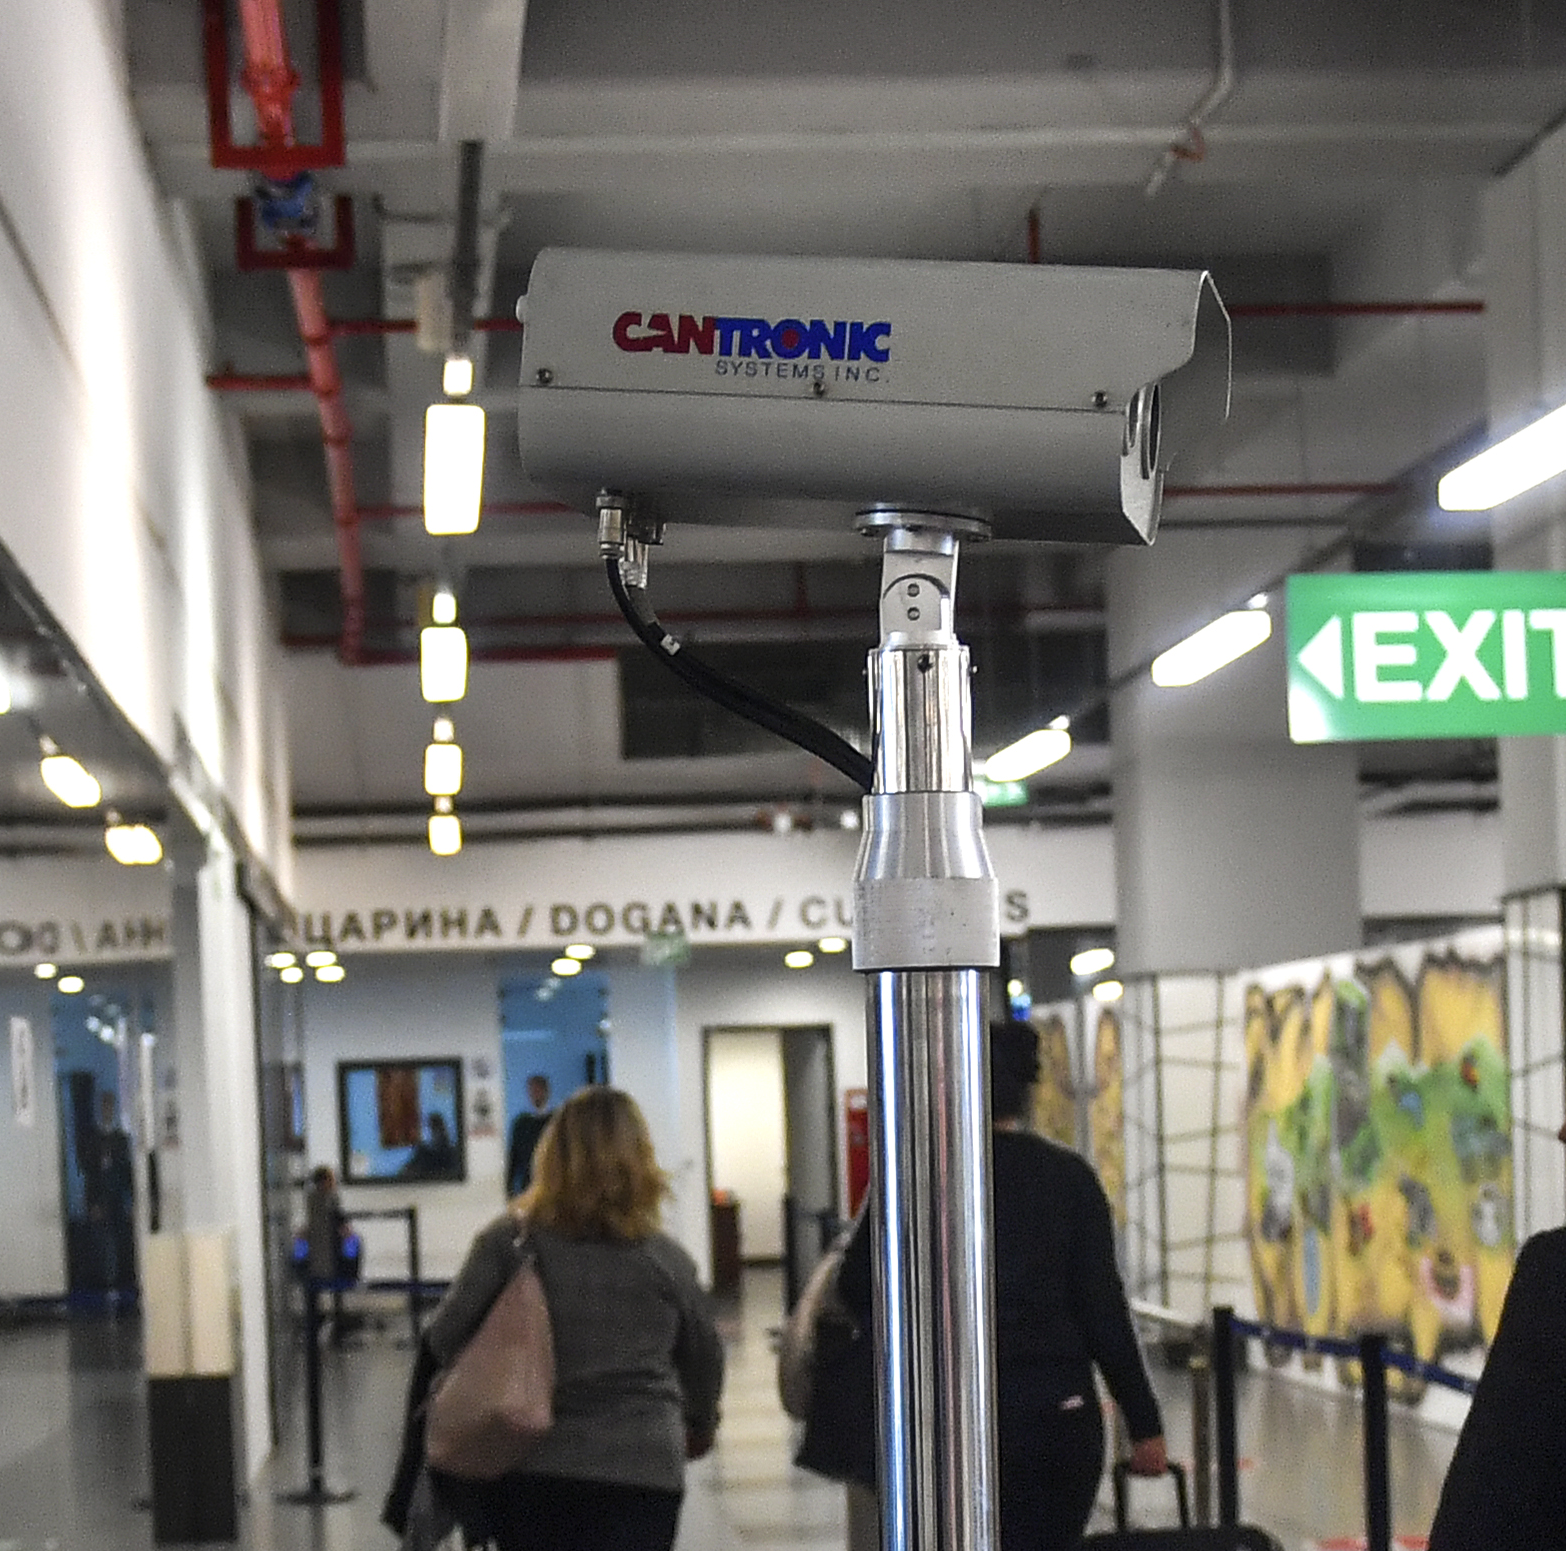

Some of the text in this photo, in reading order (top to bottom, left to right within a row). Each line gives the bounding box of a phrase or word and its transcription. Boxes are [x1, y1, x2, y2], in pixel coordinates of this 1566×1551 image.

[613, 311, 892, 363] CANTRONIC
[715, 361, 890, 384] SYSTEMS INC.
[305, 906, 502, 948] ЦАРИНА
[550, 898, 751, 936] DOGANA
